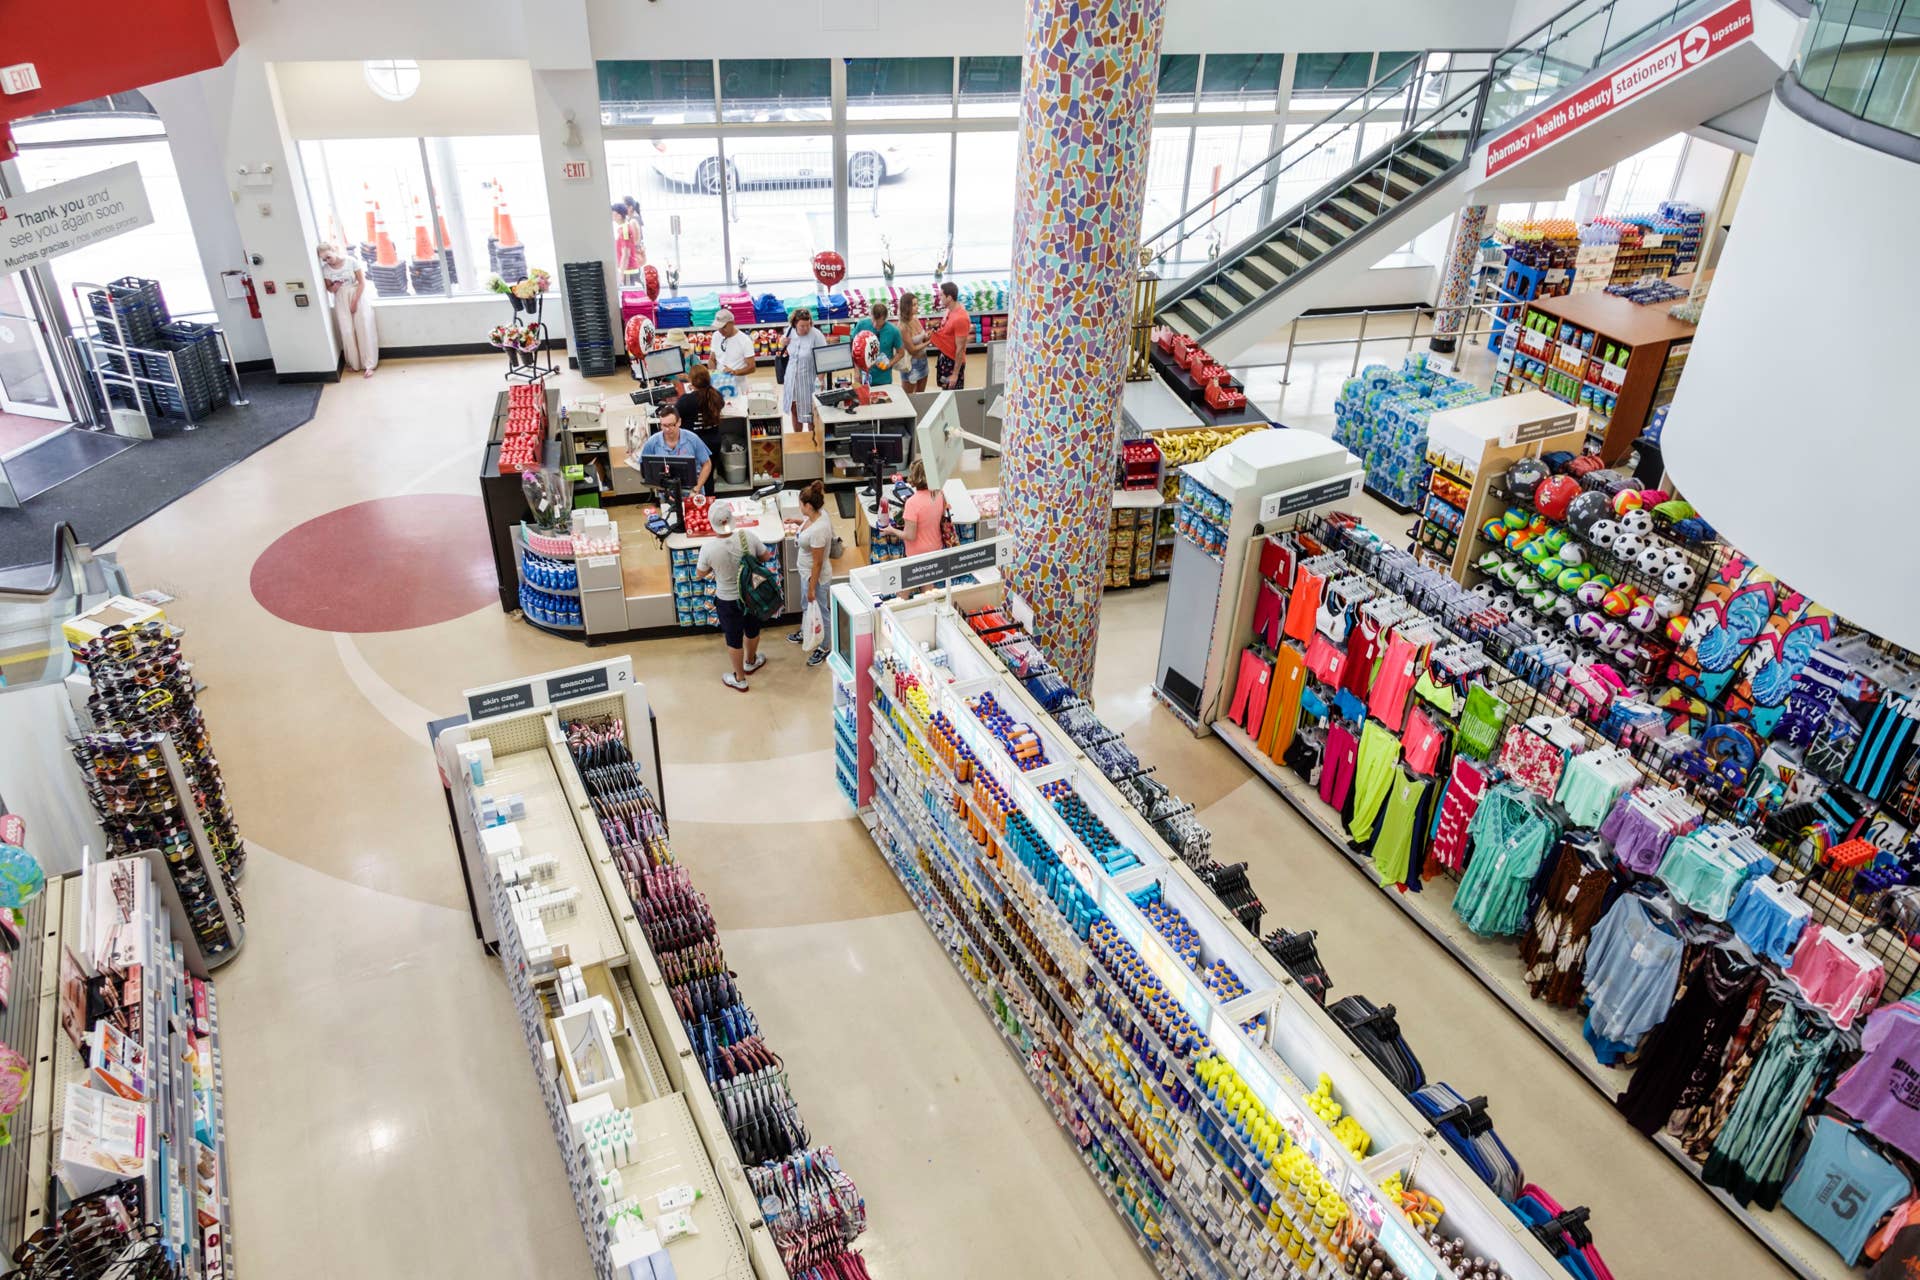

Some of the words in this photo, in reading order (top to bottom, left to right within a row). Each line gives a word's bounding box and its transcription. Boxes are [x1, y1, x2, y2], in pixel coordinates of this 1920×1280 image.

[1711, 14, 1751, 42] upstairs
[10, 68, 35, 91] EXIT
[1616, 50, 1677, 95] stationery
[1488, 133, 1530, 170] pharmacy
[1536, 111, 1567, 139] health
[1568, 105, 1575, 121] &
[1575, 88, 1612, 117] beauty
[566, 162, 585, 178] EXIT
[14, 205, 59, 228] Thank
[60, 199, 85, 218] you
[87, 188, 110, 207] and
[9, 231, 33, 249] see
[35, 224, 59, 243] you
[61, 210, 94, 231] again
[96, 201, 125, 219] soon
[4, 250, 39, 268] Muchas
[40, 240, 70, 258] gracias
[814, 262, 842, 271] Noses
[1001, 547, 1008, 557] 3
[911, 562, 939, 574] skincare
[889, 576, 896, 586] 2
[560, 675, 595, 689] seasonal
[618, 671, 627, 682] 2
[482, 696, 500, 706] skin
[500, 693, 519, 703] care
[1817, 1173, 1868, 1220] 15
